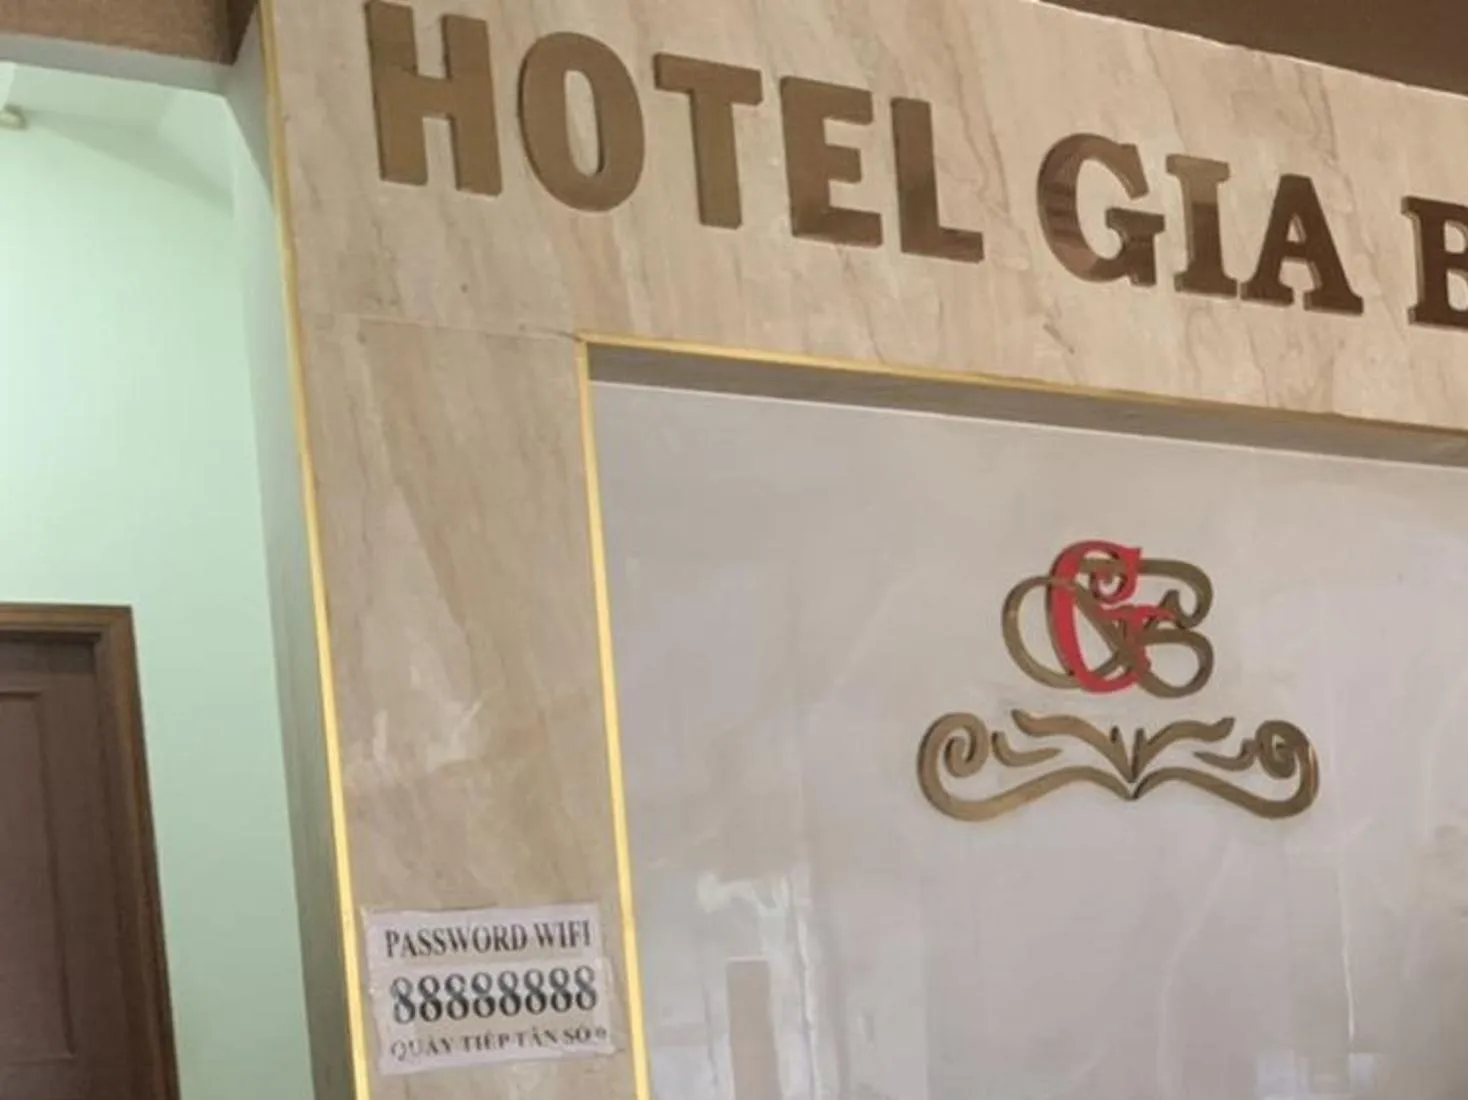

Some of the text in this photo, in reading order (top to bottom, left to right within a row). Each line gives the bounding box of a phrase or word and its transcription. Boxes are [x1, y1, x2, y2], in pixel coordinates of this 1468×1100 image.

[364, 0, 984, 264] HOTEL
[1035, 131, 1365, 316] GIA
[385, 919, 591, 958] PASSWORD WIFI
[390, 965, 598, 1024] 88888888
